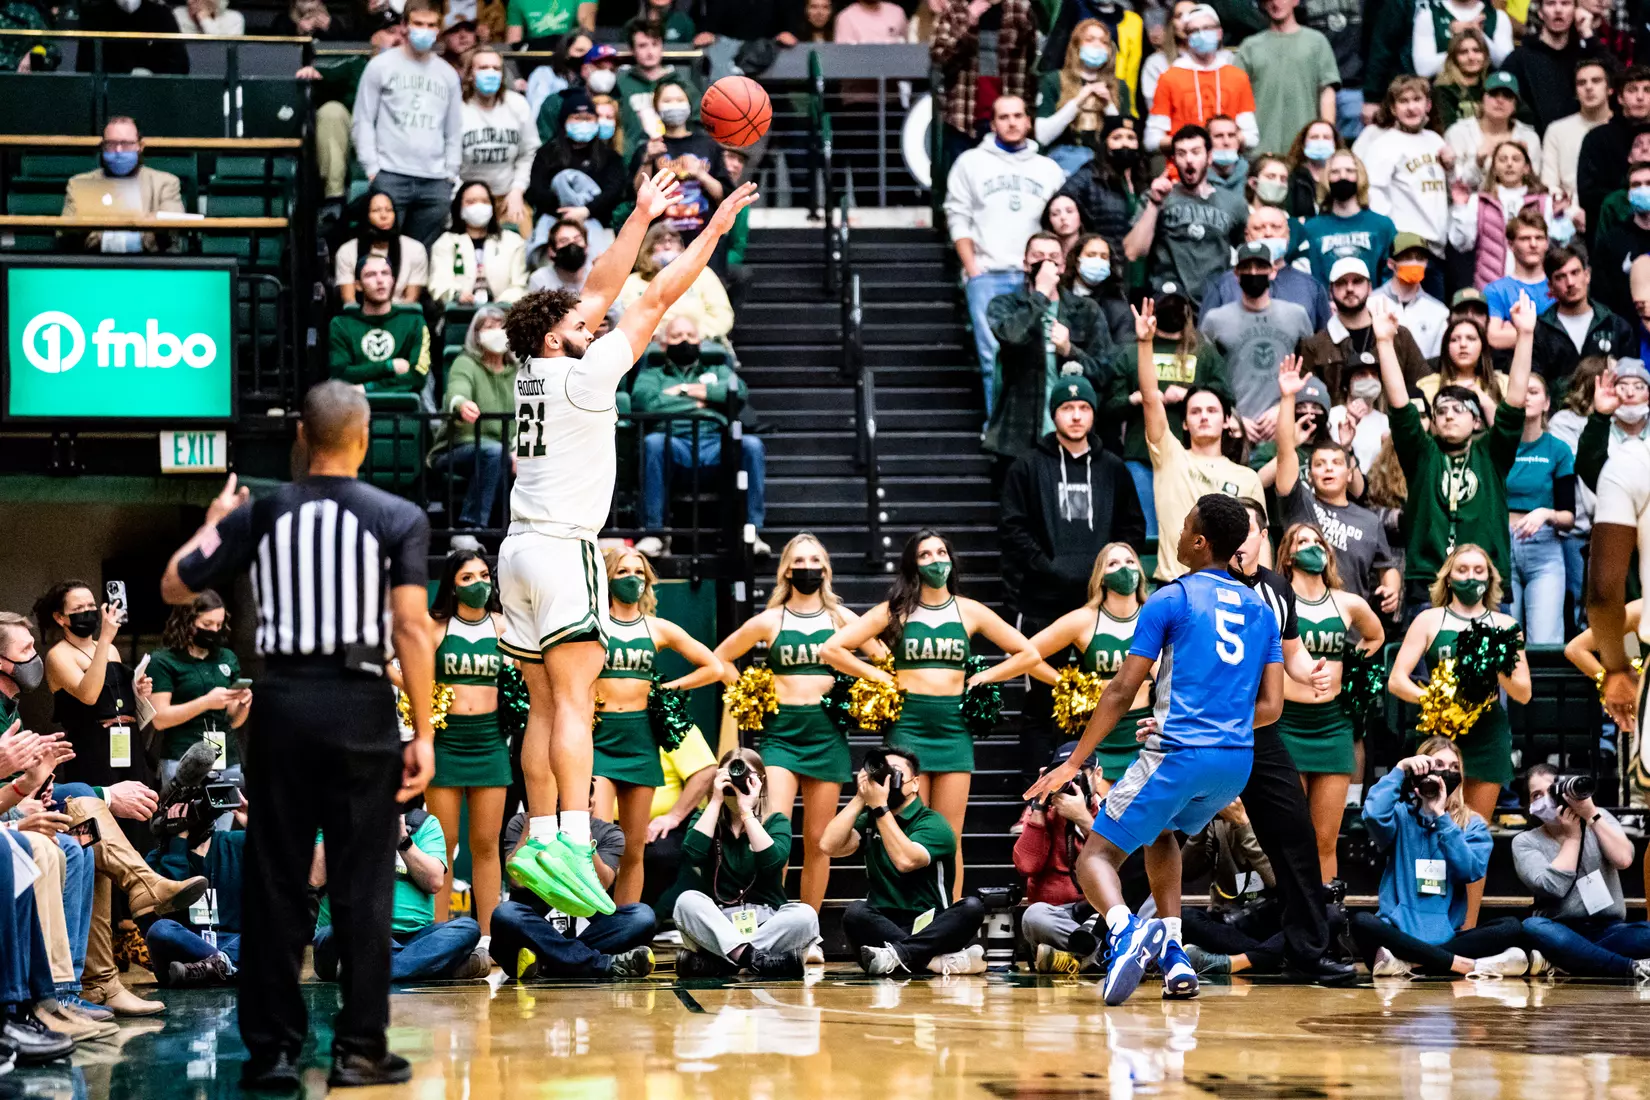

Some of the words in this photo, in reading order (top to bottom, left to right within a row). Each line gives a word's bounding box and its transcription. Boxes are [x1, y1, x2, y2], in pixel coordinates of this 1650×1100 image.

[472, 147, 509, 164] STATE
[92, 318, 217, 369] fnbo
[517, 378, 545, 396] RODDY
[517, 402, 546, 457] 21
[173, 431, 217, 466] EXIT
[905, 637, 965, 661] RAMS
[1215, 608, 1245, 666] 5
[1304, 630, 1345, 653] AMS
[444, 652, 500, 677] RAMS
[780, 643, 825, 666] RAM
[1096, 650, 1129, 673] RA
